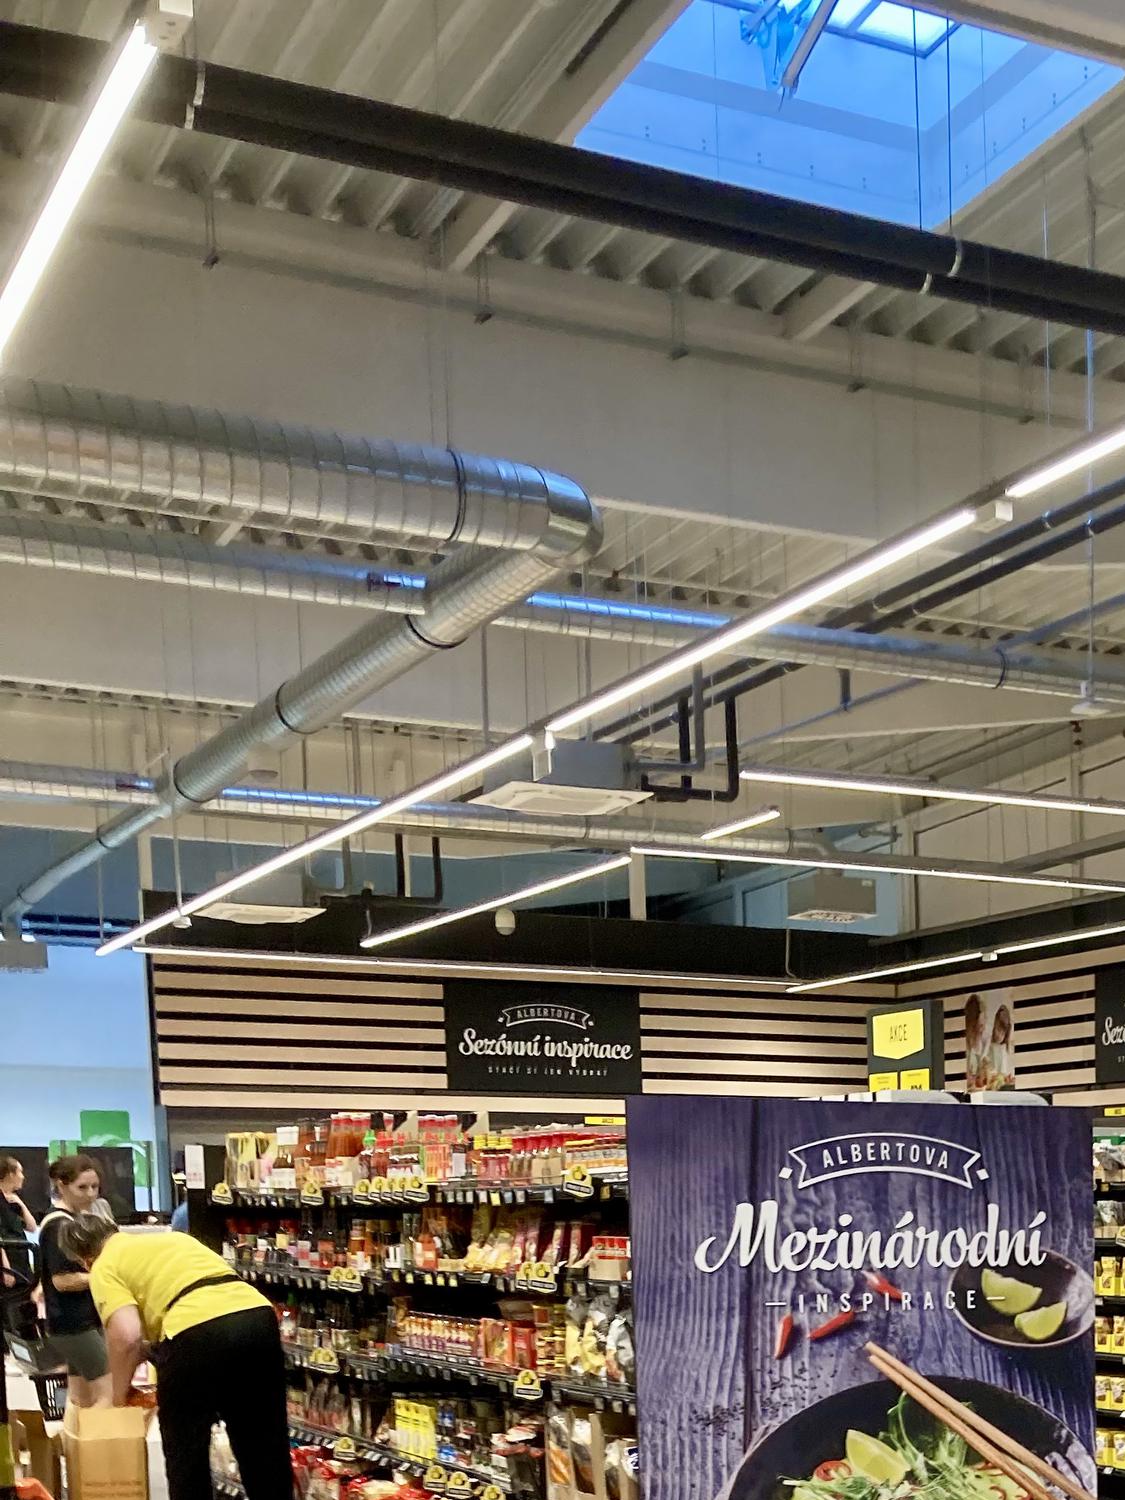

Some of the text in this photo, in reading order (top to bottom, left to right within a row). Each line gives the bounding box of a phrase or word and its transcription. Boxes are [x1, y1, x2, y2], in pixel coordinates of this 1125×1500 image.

[516, 1007, 576, 1022] ALBERTOVA
[889, 1023, 908, 1042] AKCE
[458, 1028, 633, 1067] Sezónní inspirace
[822, 1142, 949, 1169] ALBERTOVA
[694, 1200, 1047, 1274] Mezinárodní
[799, 1289, 977, 1313] INSPIRACE
